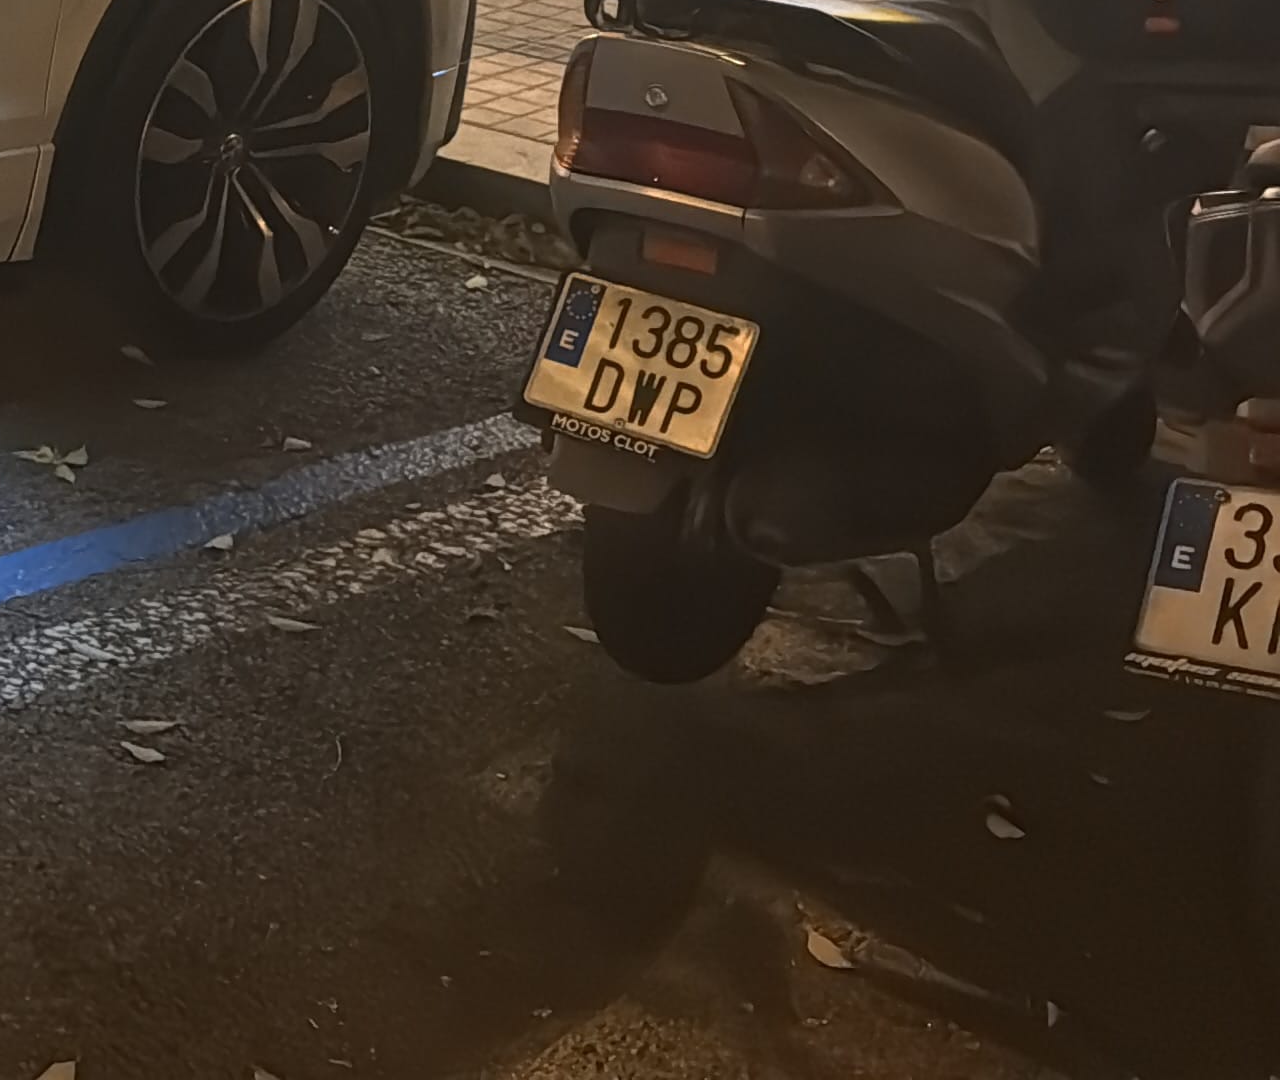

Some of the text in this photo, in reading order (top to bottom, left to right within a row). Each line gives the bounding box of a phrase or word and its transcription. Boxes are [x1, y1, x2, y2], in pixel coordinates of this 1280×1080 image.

[559, 329, 580, 351] E
[609, 297, 741, 379] 1385
[584, 358, 703, 434] DWP
[551, 413, 612, 443] MOTOS
[613, 434, 660, 458] CLOT
[1171, 544, 1196, 571] E
[1224, 502, 1280, 574] 3
